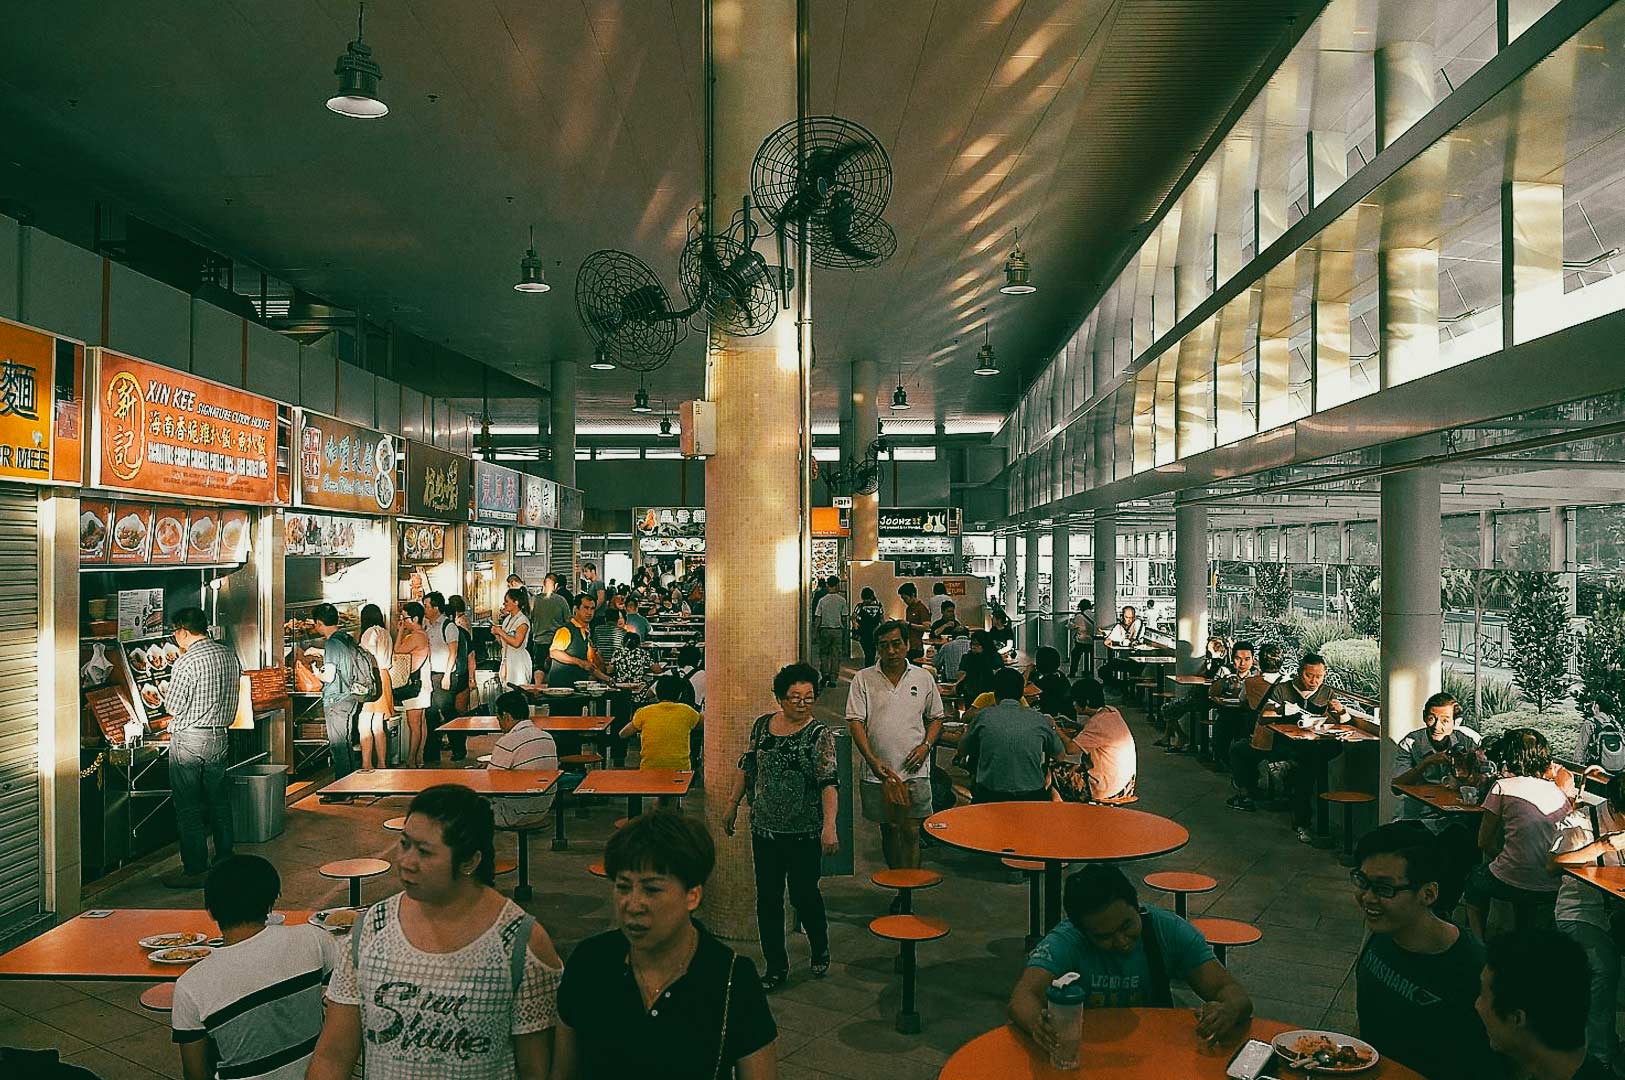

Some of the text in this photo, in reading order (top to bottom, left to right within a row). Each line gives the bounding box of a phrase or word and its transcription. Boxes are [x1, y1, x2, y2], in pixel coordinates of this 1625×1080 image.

[146, 380, 171, 406] XIN
[172, 387, 197, 413] KEE
[15, 446, 50, 472] MEE
